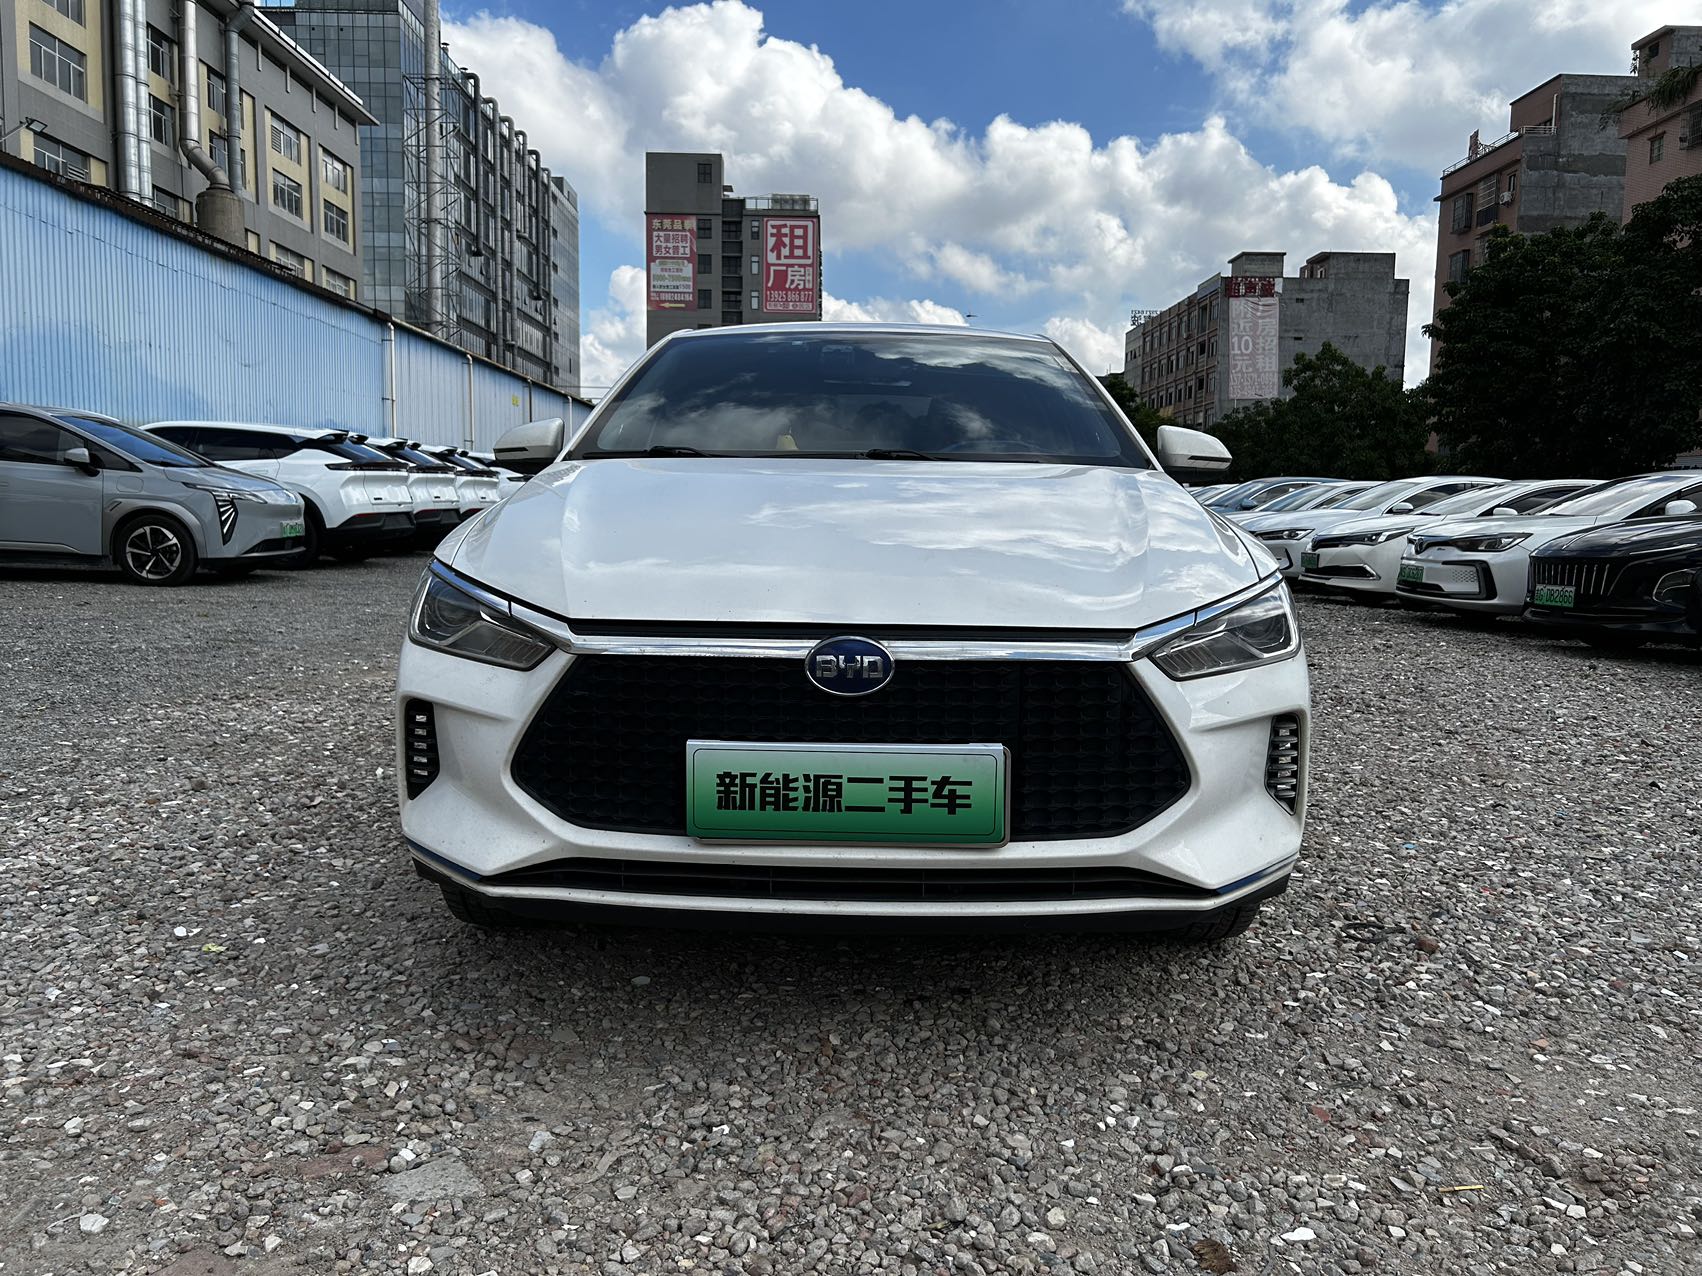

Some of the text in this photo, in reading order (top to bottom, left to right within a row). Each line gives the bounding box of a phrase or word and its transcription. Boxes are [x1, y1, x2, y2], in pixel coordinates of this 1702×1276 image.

[655, 233, 689, 245] 大量招聘
[655, 245, 689, 256] 男女普工
[769, 223, 811, 261] 租
[768, 266, 804, 289] 厂房
[767, 291, 787, 302] 13925
[815, 655, 884, 679] BYD
[715, 771, 973, 815] 新能源二手车
